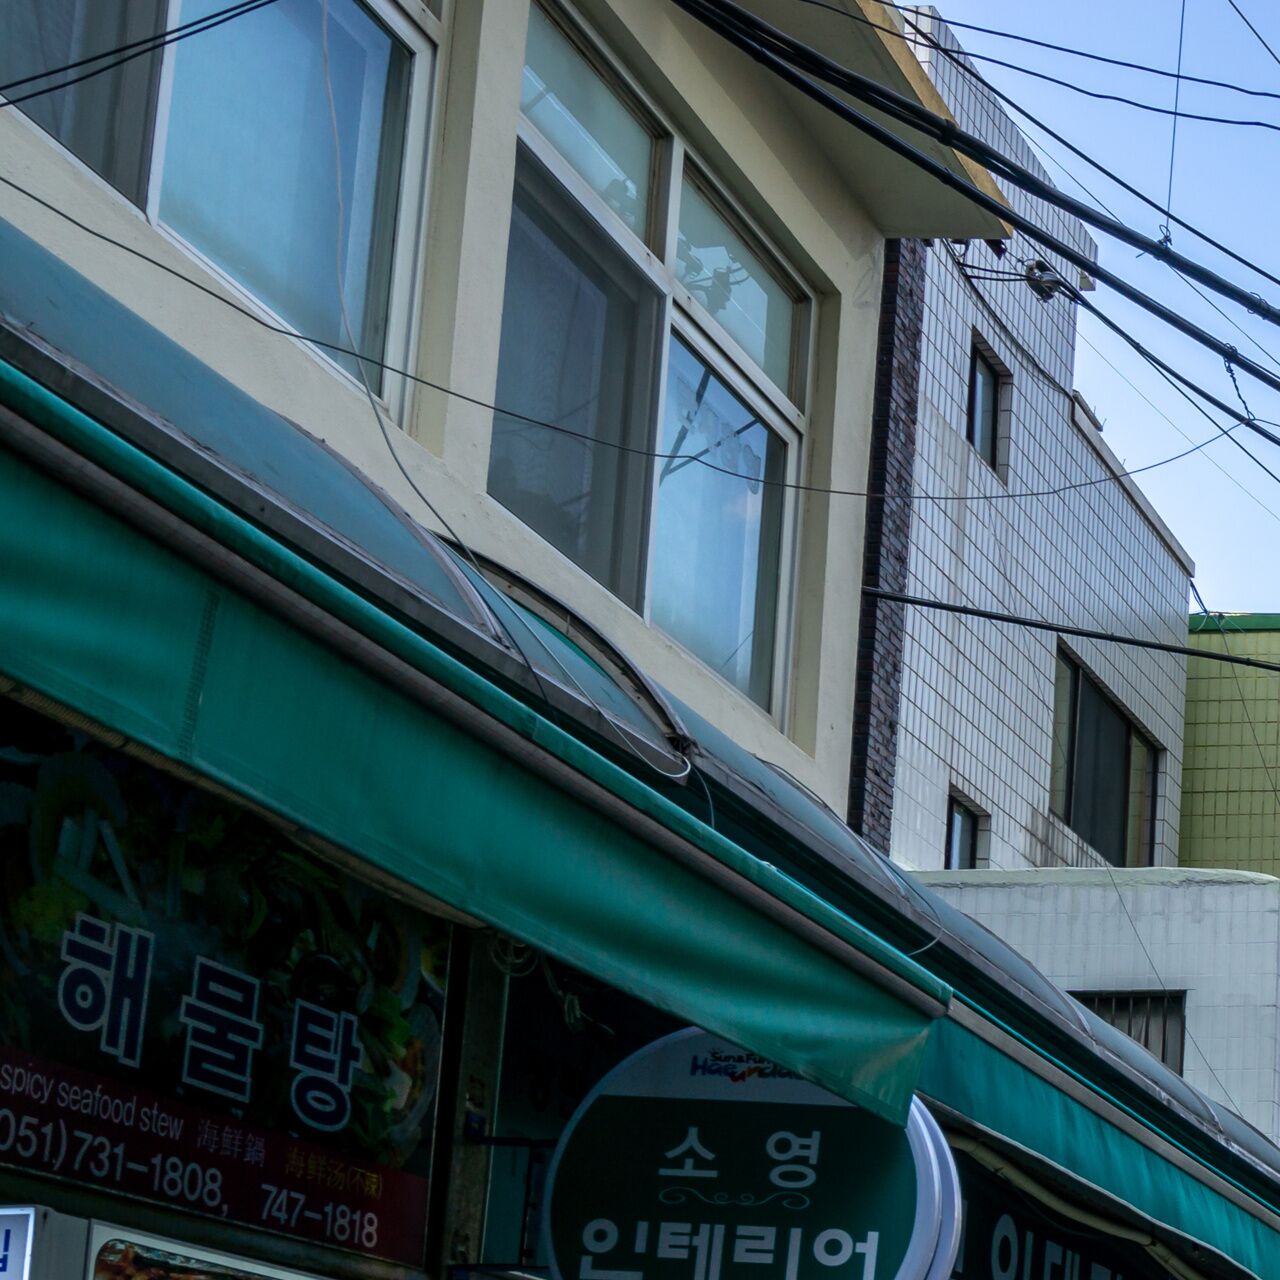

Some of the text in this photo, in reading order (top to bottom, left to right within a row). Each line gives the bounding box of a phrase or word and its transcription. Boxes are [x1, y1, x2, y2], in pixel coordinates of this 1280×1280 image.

[58, 911, 363, 1132] 해물탕
[56, 1080, 135, 1129] seafood
[139, 1102, 186, 1142] stew
[259, 1182, 379, 1249] 747-1818
